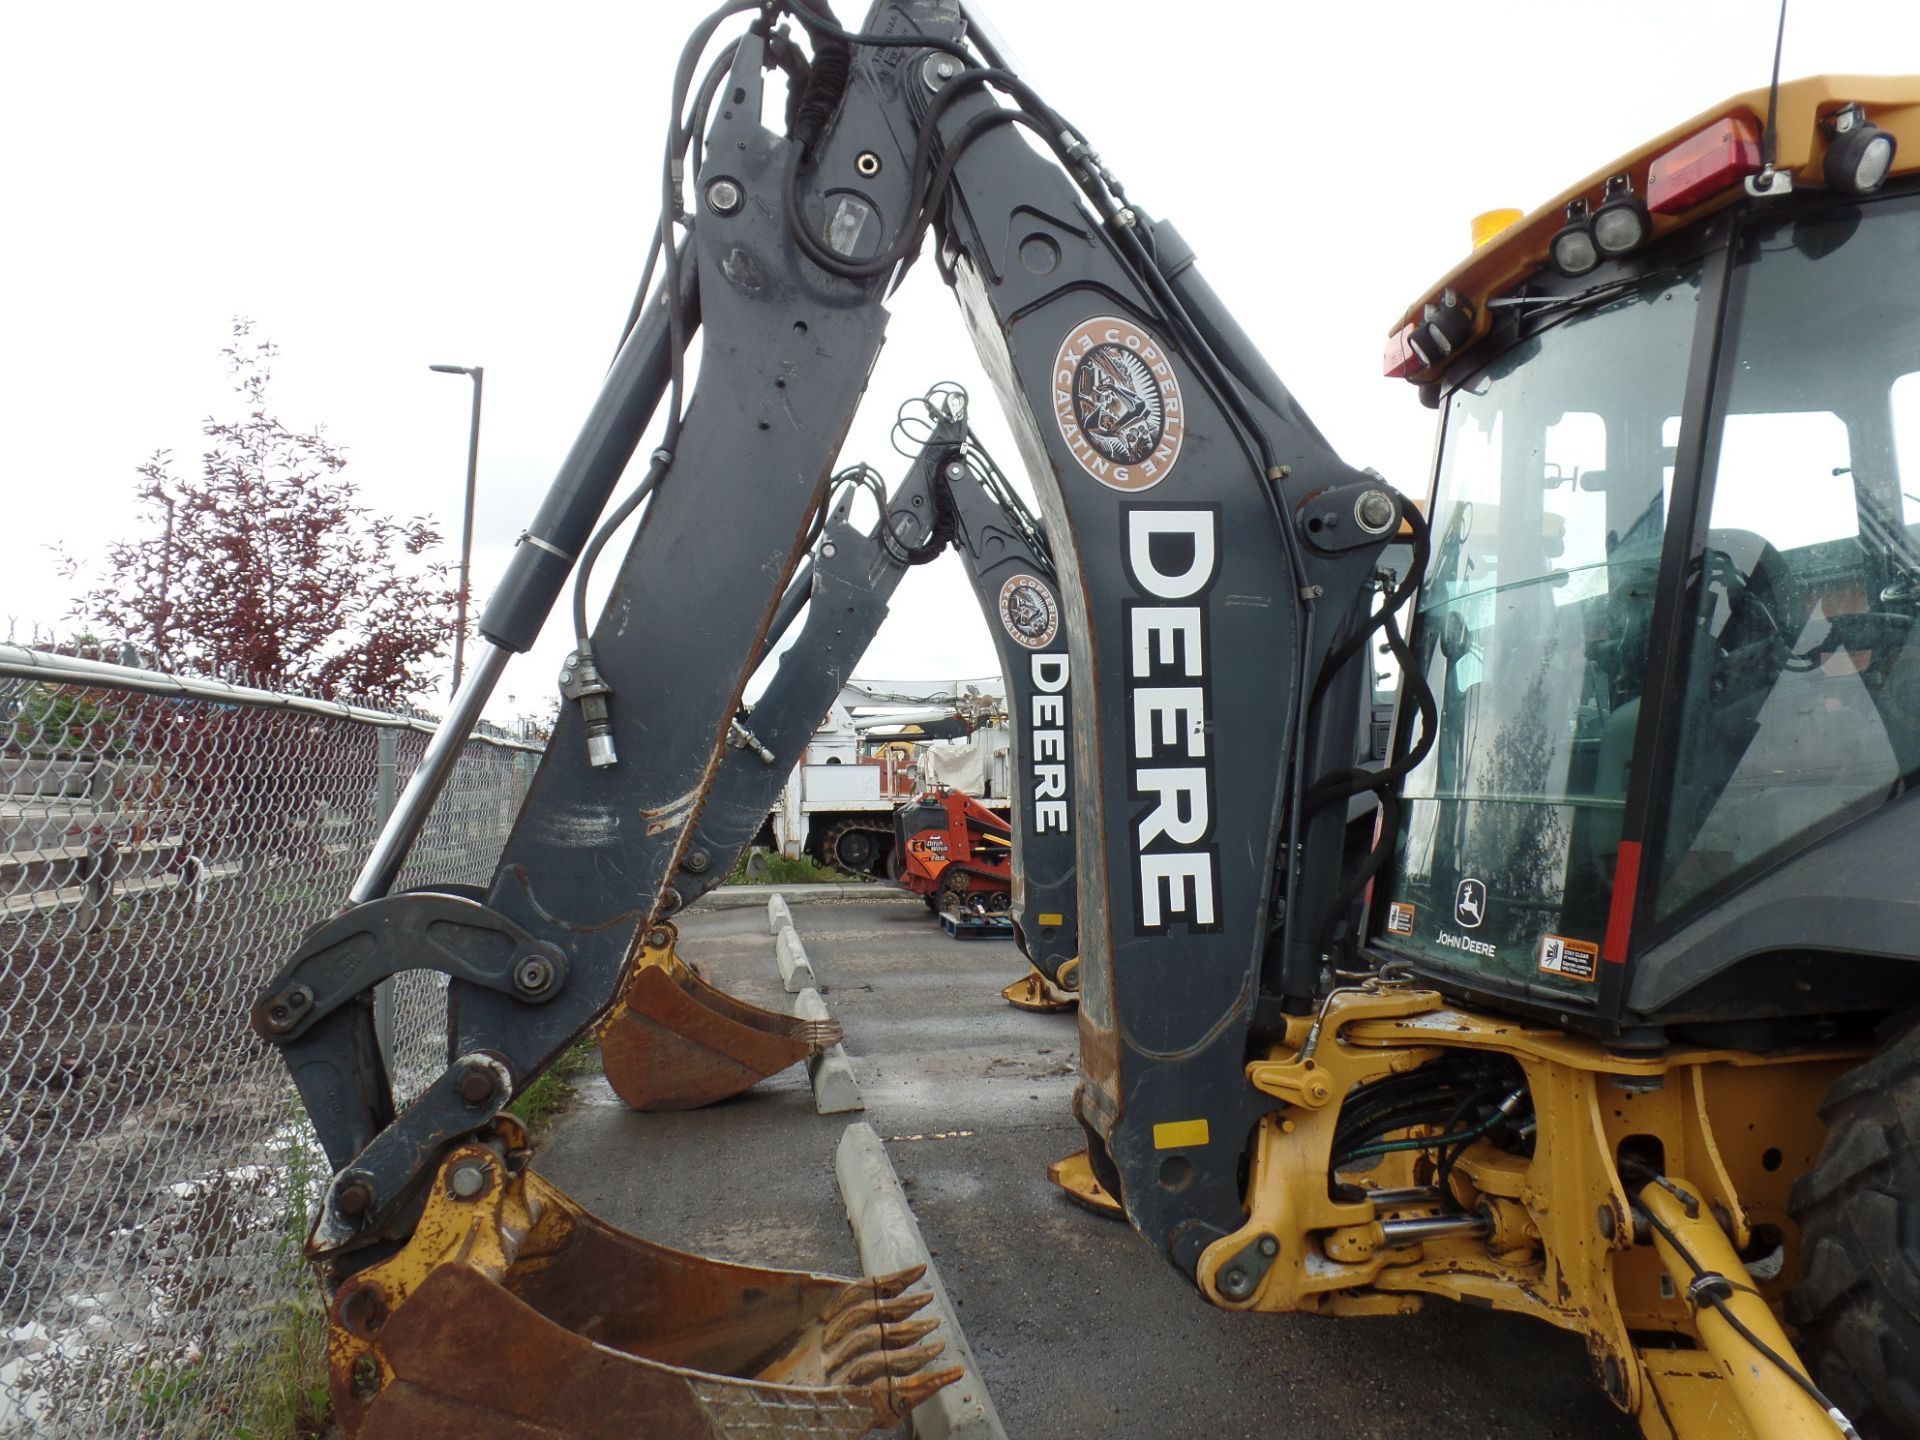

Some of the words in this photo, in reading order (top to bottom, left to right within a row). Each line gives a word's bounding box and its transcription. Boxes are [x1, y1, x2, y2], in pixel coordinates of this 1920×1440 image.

[1056, 334, 1130, 481] EXCAVATING
[1105, 328, 1178, 477] COPPERLINE
[1001, 583, 1037, 645] EXCAVATING
[1019, 579, 1055, 642] COPPERLINE
[1031, 653, 1069, 833] DEERE
[1128, 510, 1216, 927] DEERE
[1435, 930, 1461, 949] JOHN
[1461, 935, 1497, 958] DEERE
